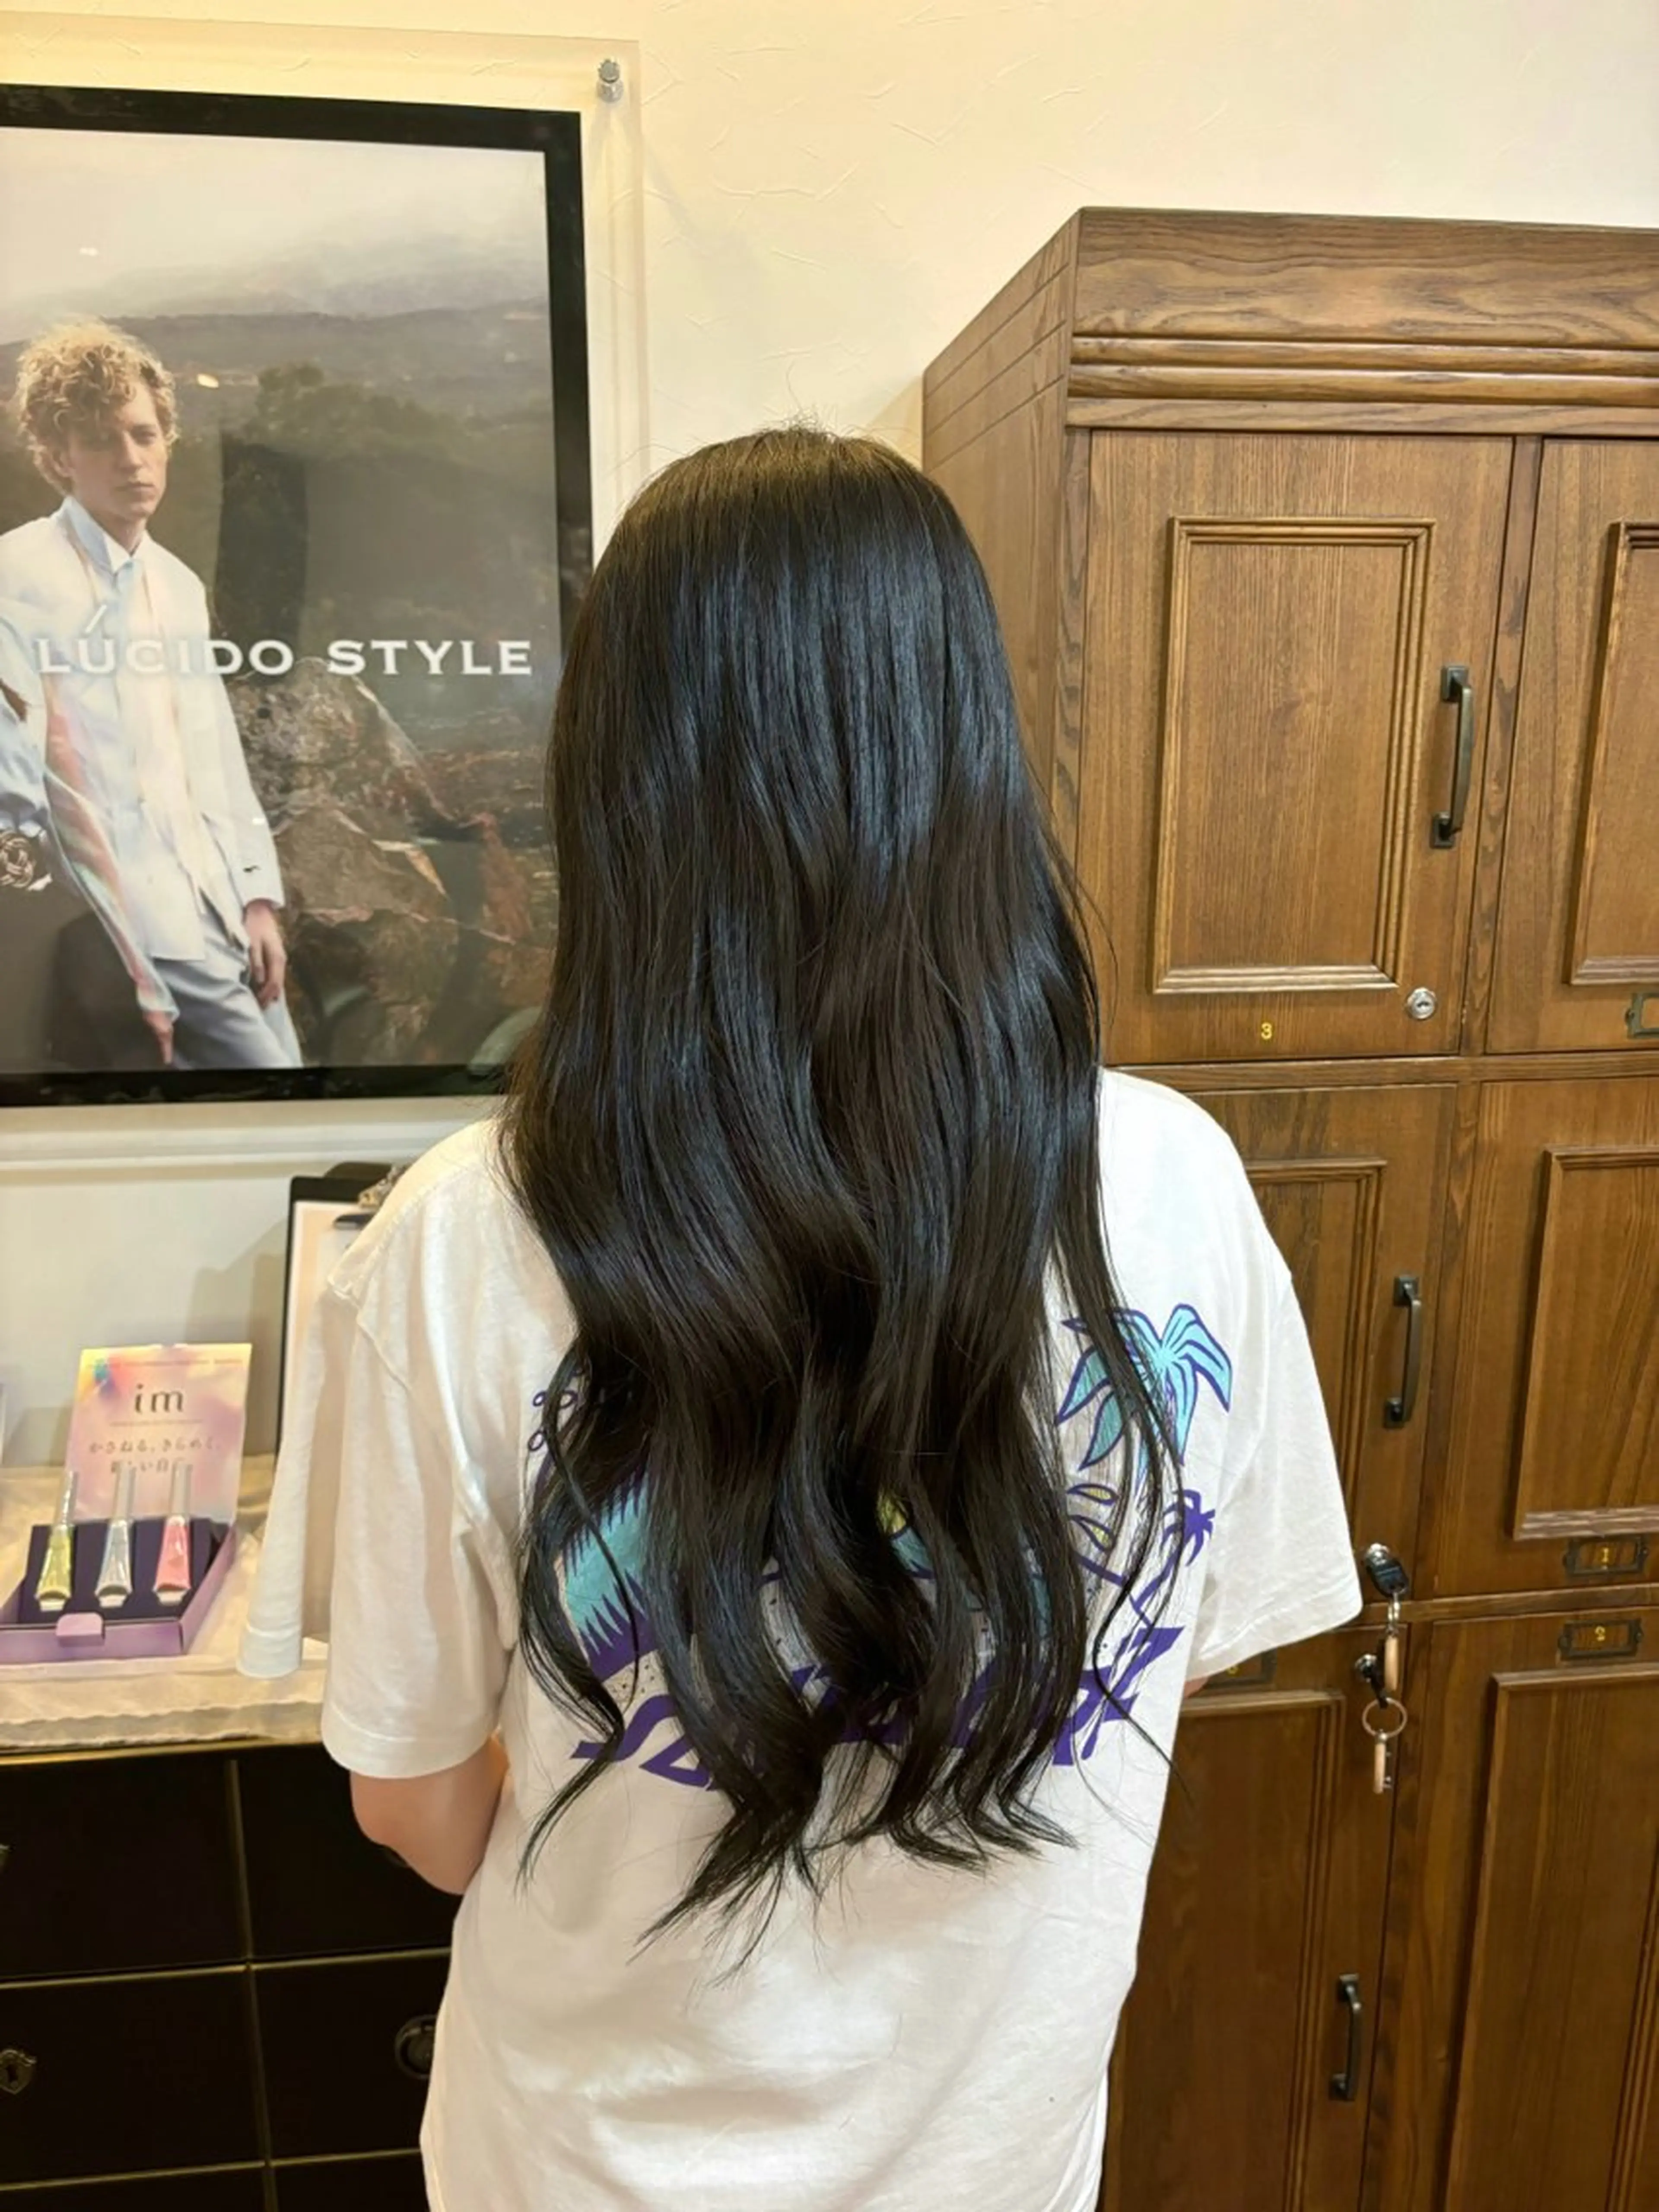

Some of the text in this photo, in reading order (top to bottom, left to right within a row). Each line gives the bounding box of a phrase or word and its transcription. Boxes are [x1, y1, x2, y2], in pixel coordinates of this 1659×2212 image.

[36, 604, 533, 676] LÚCIDO STYLE
[1261, 1022, 1272, 1040] 3
[134, 1383, 184, 1414] im
